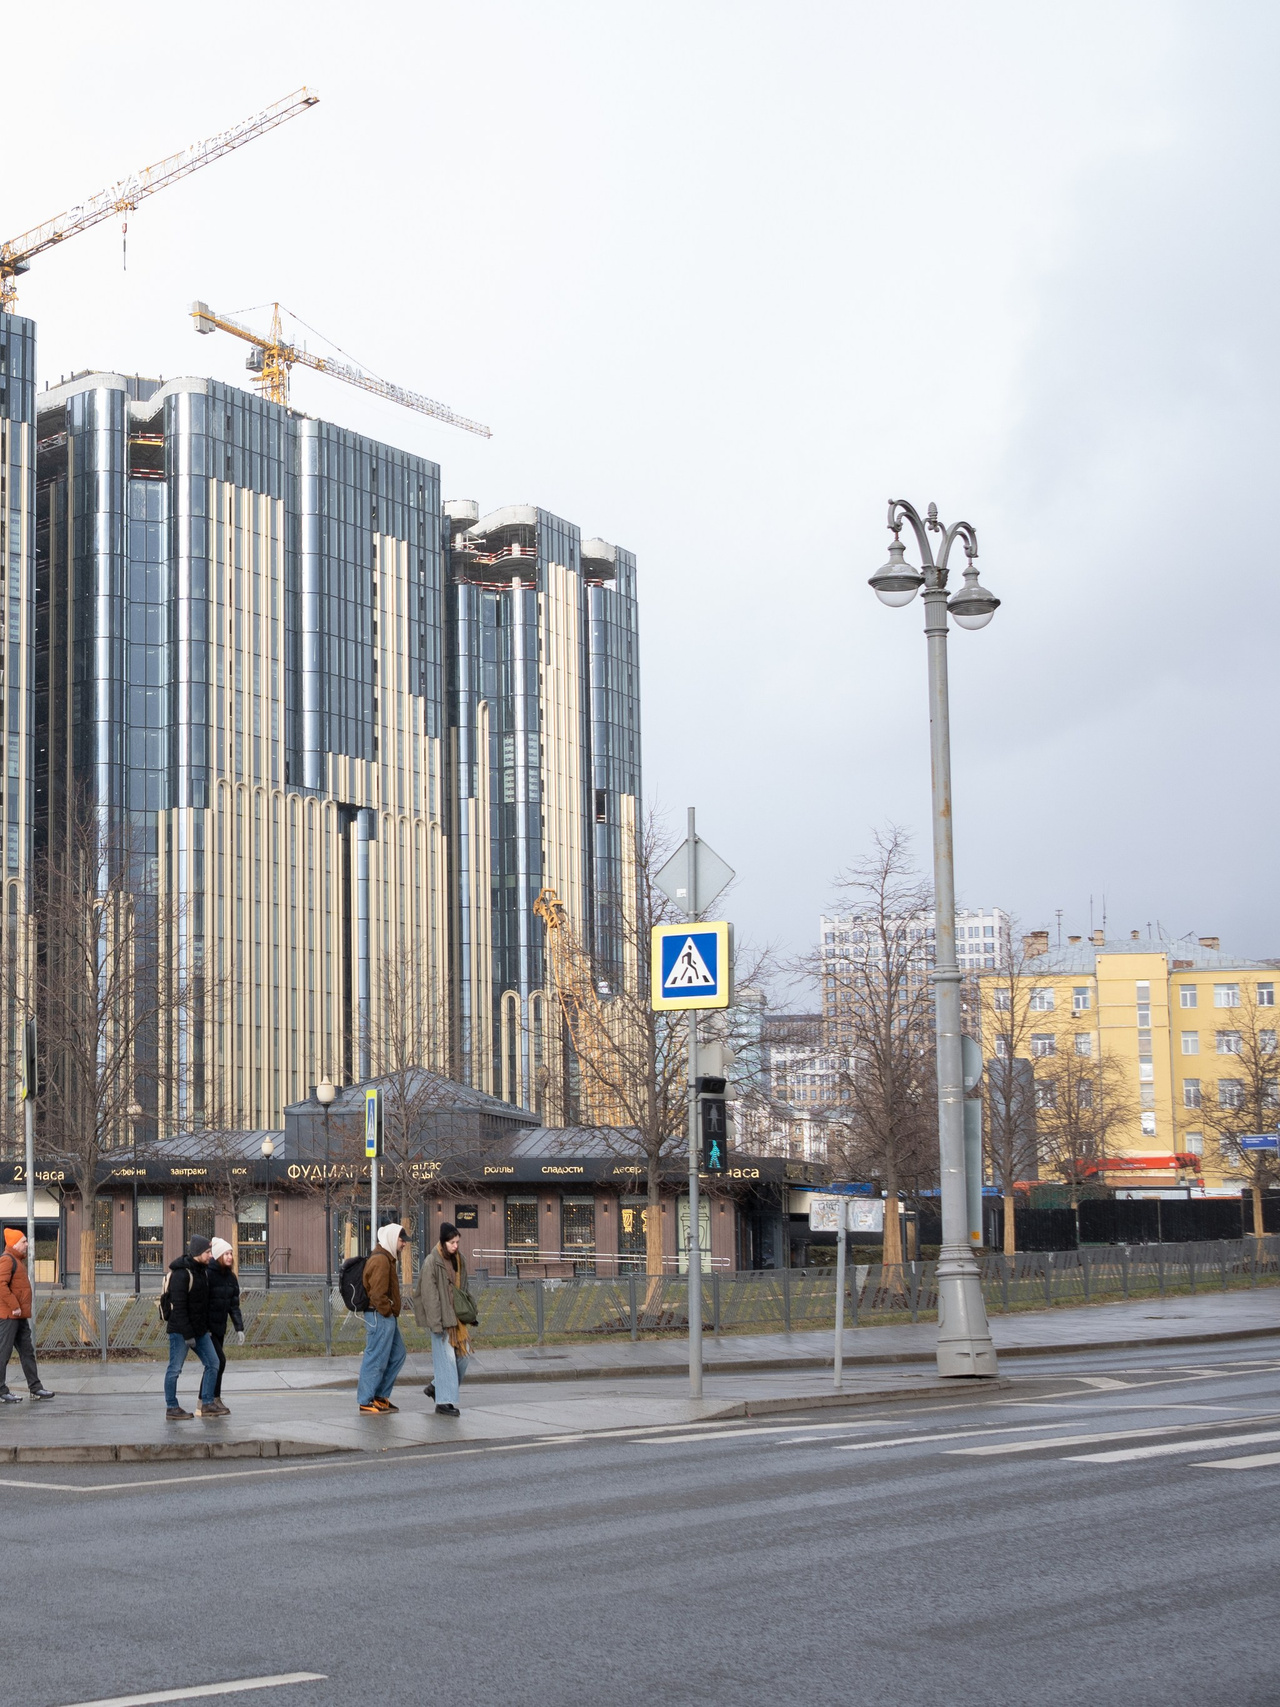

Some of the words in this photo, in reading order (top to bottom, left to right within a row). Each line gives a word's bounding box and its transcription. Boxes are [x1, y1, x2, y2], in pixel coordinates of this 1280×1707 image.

[170, 1167, 207, 1177] завтраки
[484, 1166, 514, 1175] роллы
[541, 1166, 584, 1175] сладости
[35, 1170, 65, 1181] часа
